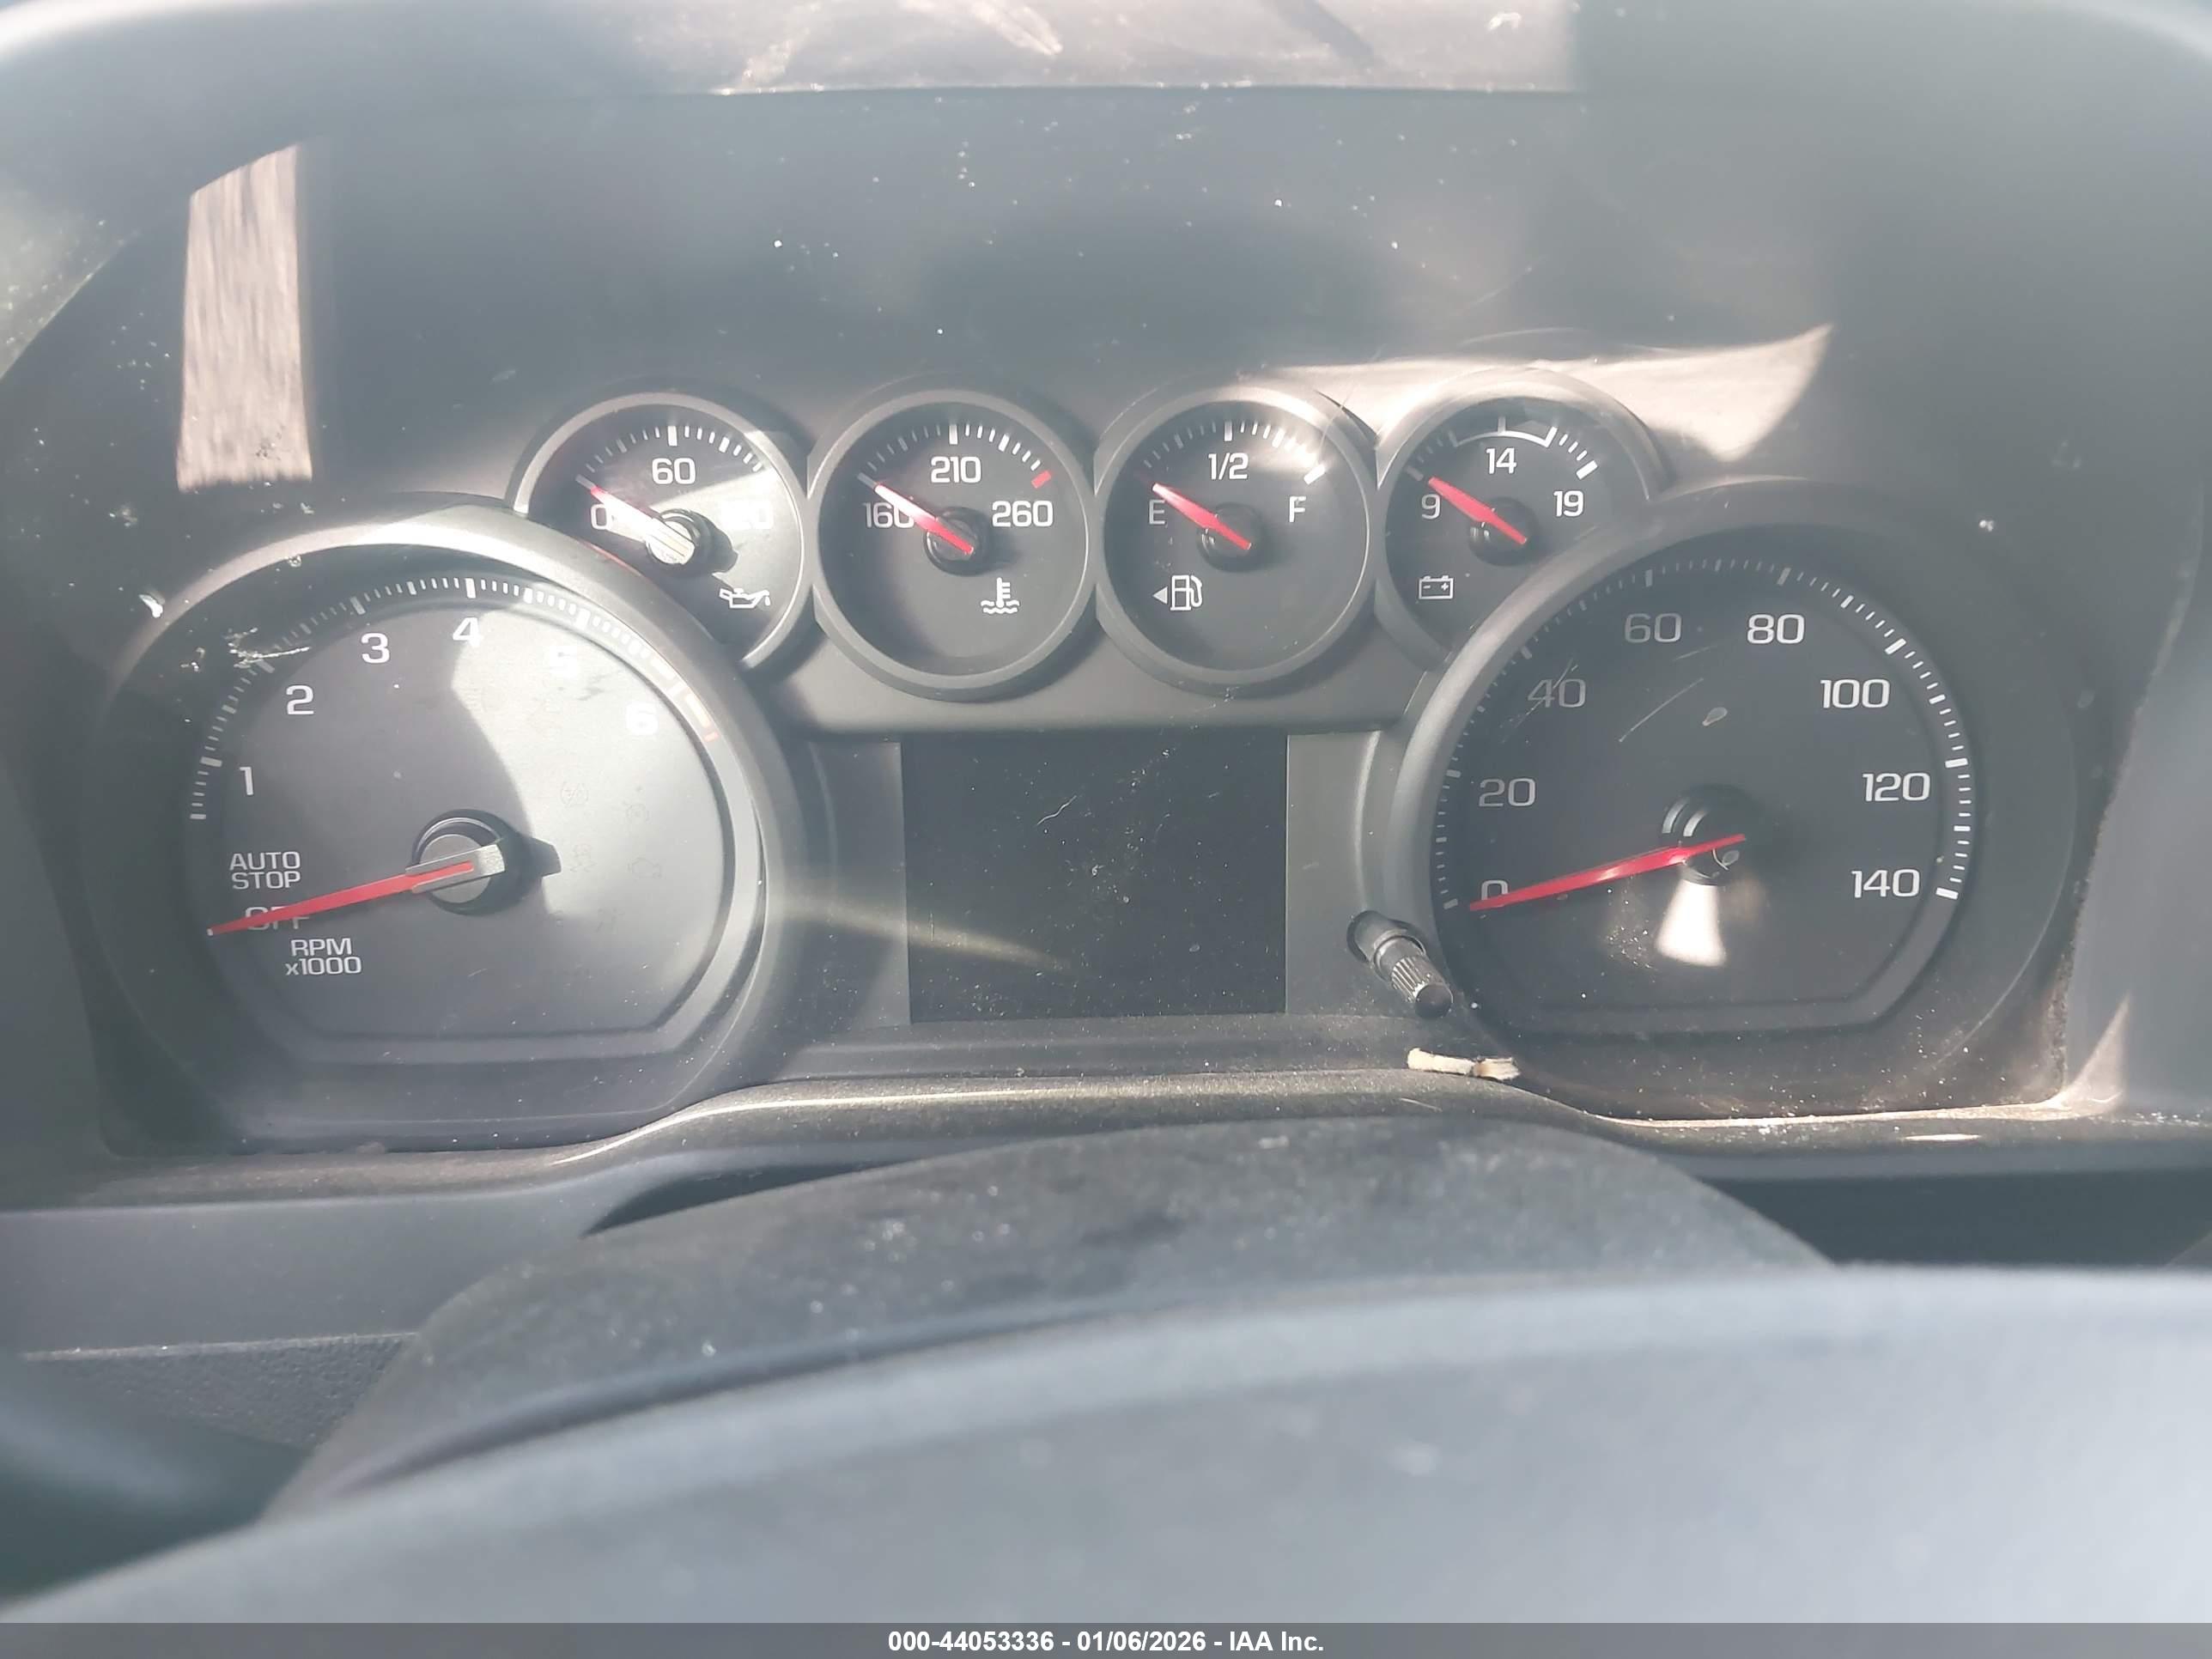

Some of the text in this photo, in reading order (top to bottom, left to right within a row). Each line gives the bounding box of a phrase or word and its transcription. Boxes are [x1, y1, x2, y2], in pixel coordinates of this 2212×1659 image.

[653, 459, 696, 484] 60
[932, 457, 981, 483] 210
[1209, 453, 1249, 479] 1/2
[1486, 448, 1516, 474] 14
[864, 502, 915, 528] 160
[993, 501, 1053, 526] 260
[1149, 501, 1168, 525] E
[1290, 496, 1306, 522] F
[1422, 495, 1440, 519] 9
[1554, 491, 1583, 516] 19
[590, 504, 611, 530] 0
[453, 617, 483, 647] 4
[1626, 614, 1681, 642] 60
[1747, 615, 1804, 643] 80
[362, 633, 389, 663] 3
[287, 685, 313, 714] 2
[1528, 679, 1585, 708] 40
[1820, 679, 1889, 708] 100
[625, 703, 658, 735] 6
[240, 767, 253, 795] 1
[1480, 779, 1535, 805] 20
[1863, 773, 1929, 801] 120
[231, 852, 300, 870] AUTO
[233, 871, 300, 889] STOP
[1852, 869, 1919, 897] 140
[291, 939, 351, 956] RPM
[286, 957, 361, 975] x1000
